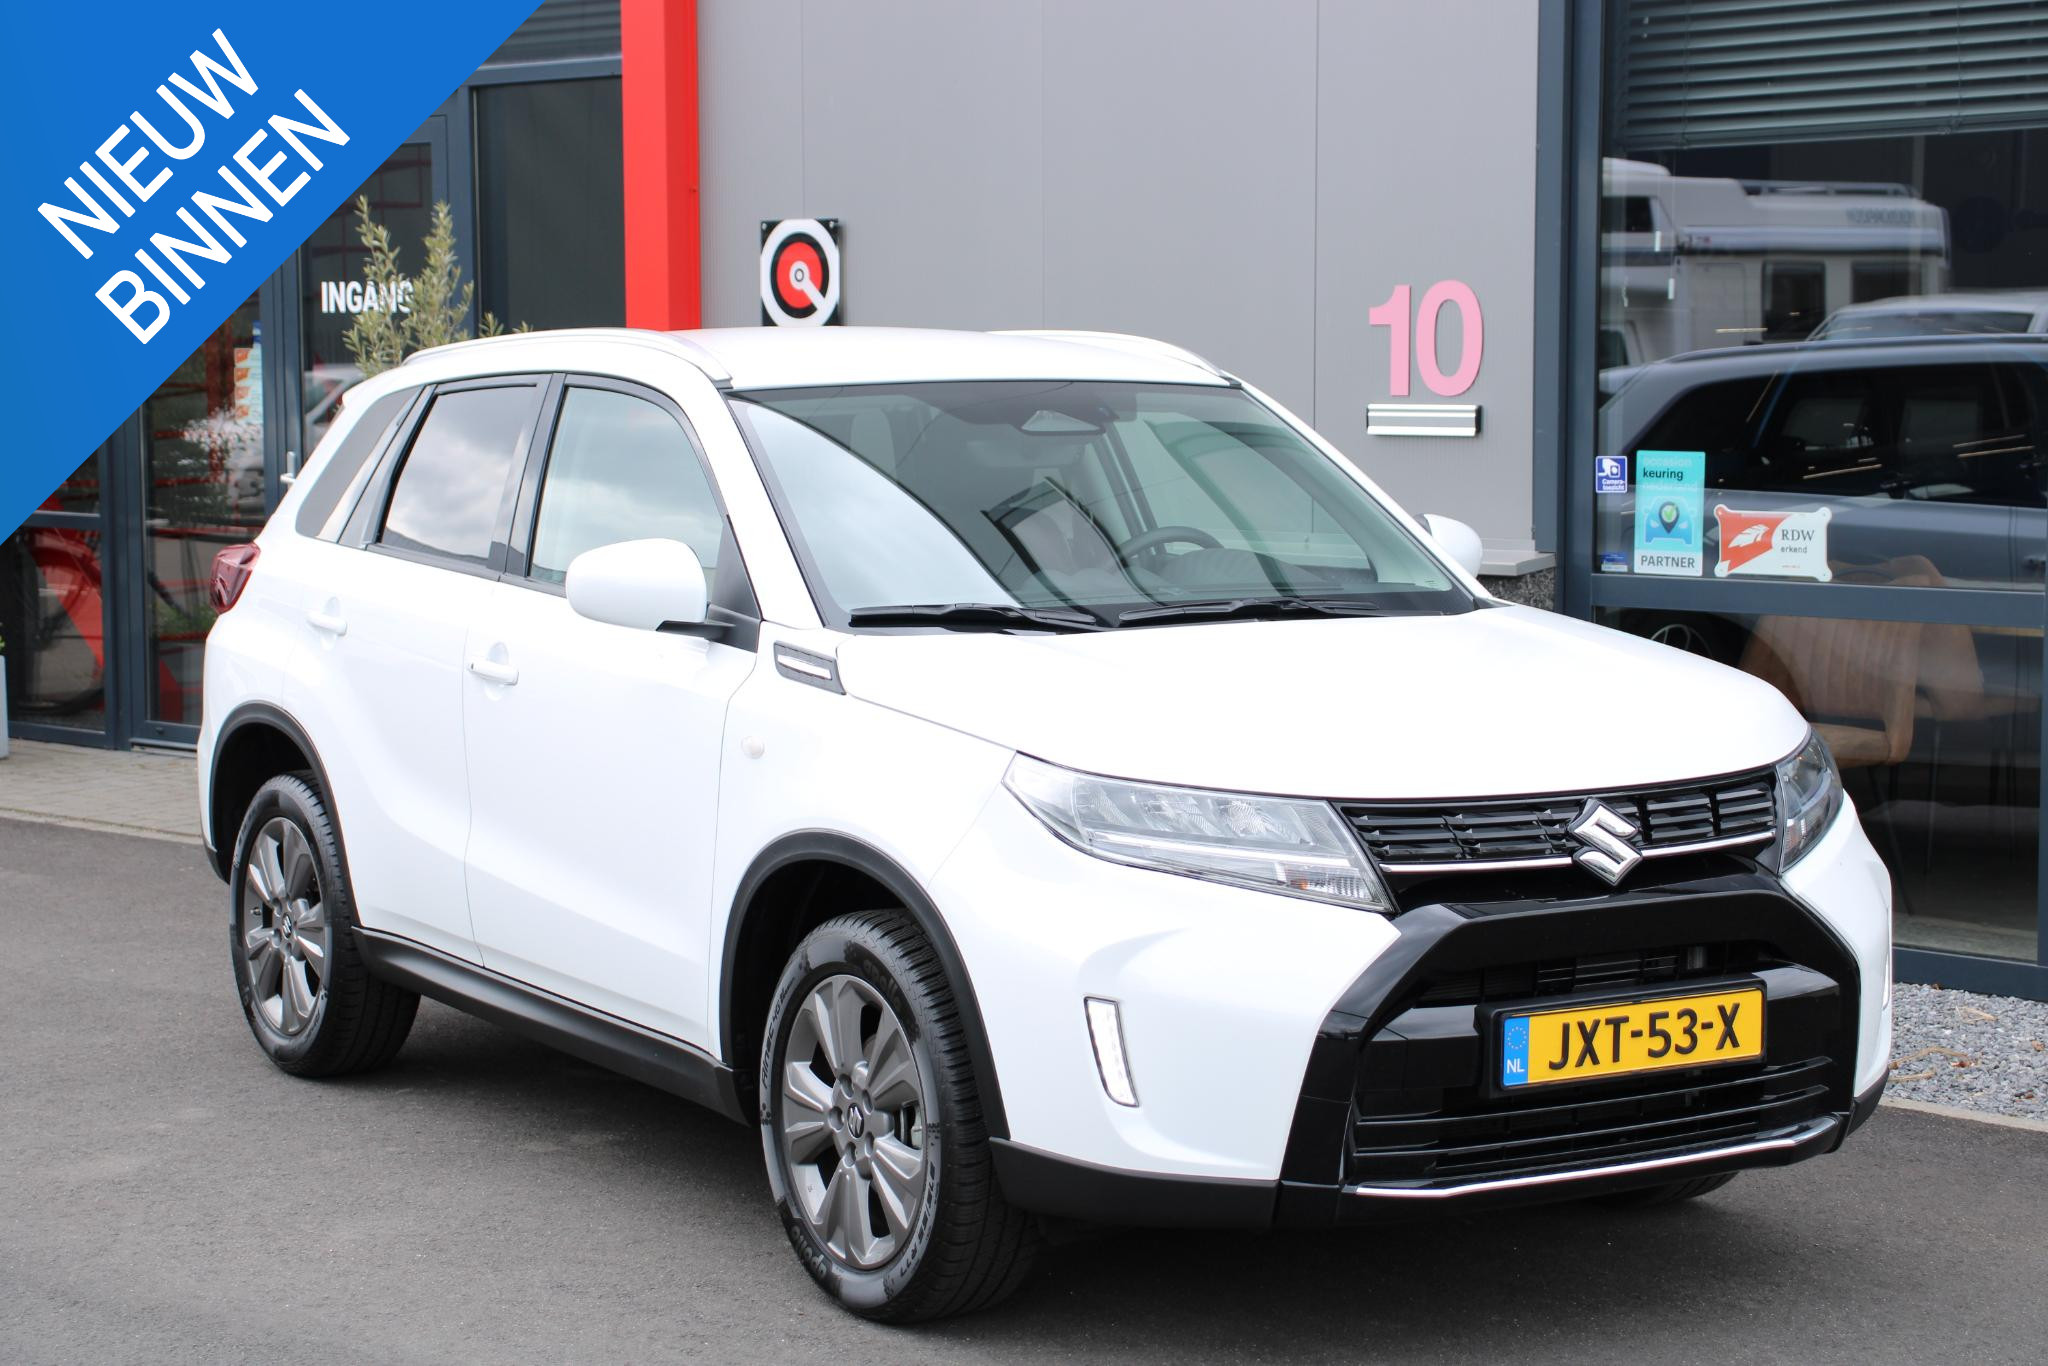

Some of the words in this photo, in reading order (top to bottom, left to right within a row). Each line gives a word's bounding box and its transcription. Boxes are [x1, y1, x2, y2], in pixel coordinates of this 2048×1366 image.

[320, 279, 415, 314] INGANG
[1369, 280, 1485, 397] 10
[1643, 467, 1684, 481] keuring
[1781, 529, 1815, 541] RDW
[1780, 545, 1808, 554] erkend
[1640, 554, 1695, 568] PARTNER
[1506, 1057, 1525, 1075] NL
[1548, 1002, 1741, 1071] JXT-53-X
